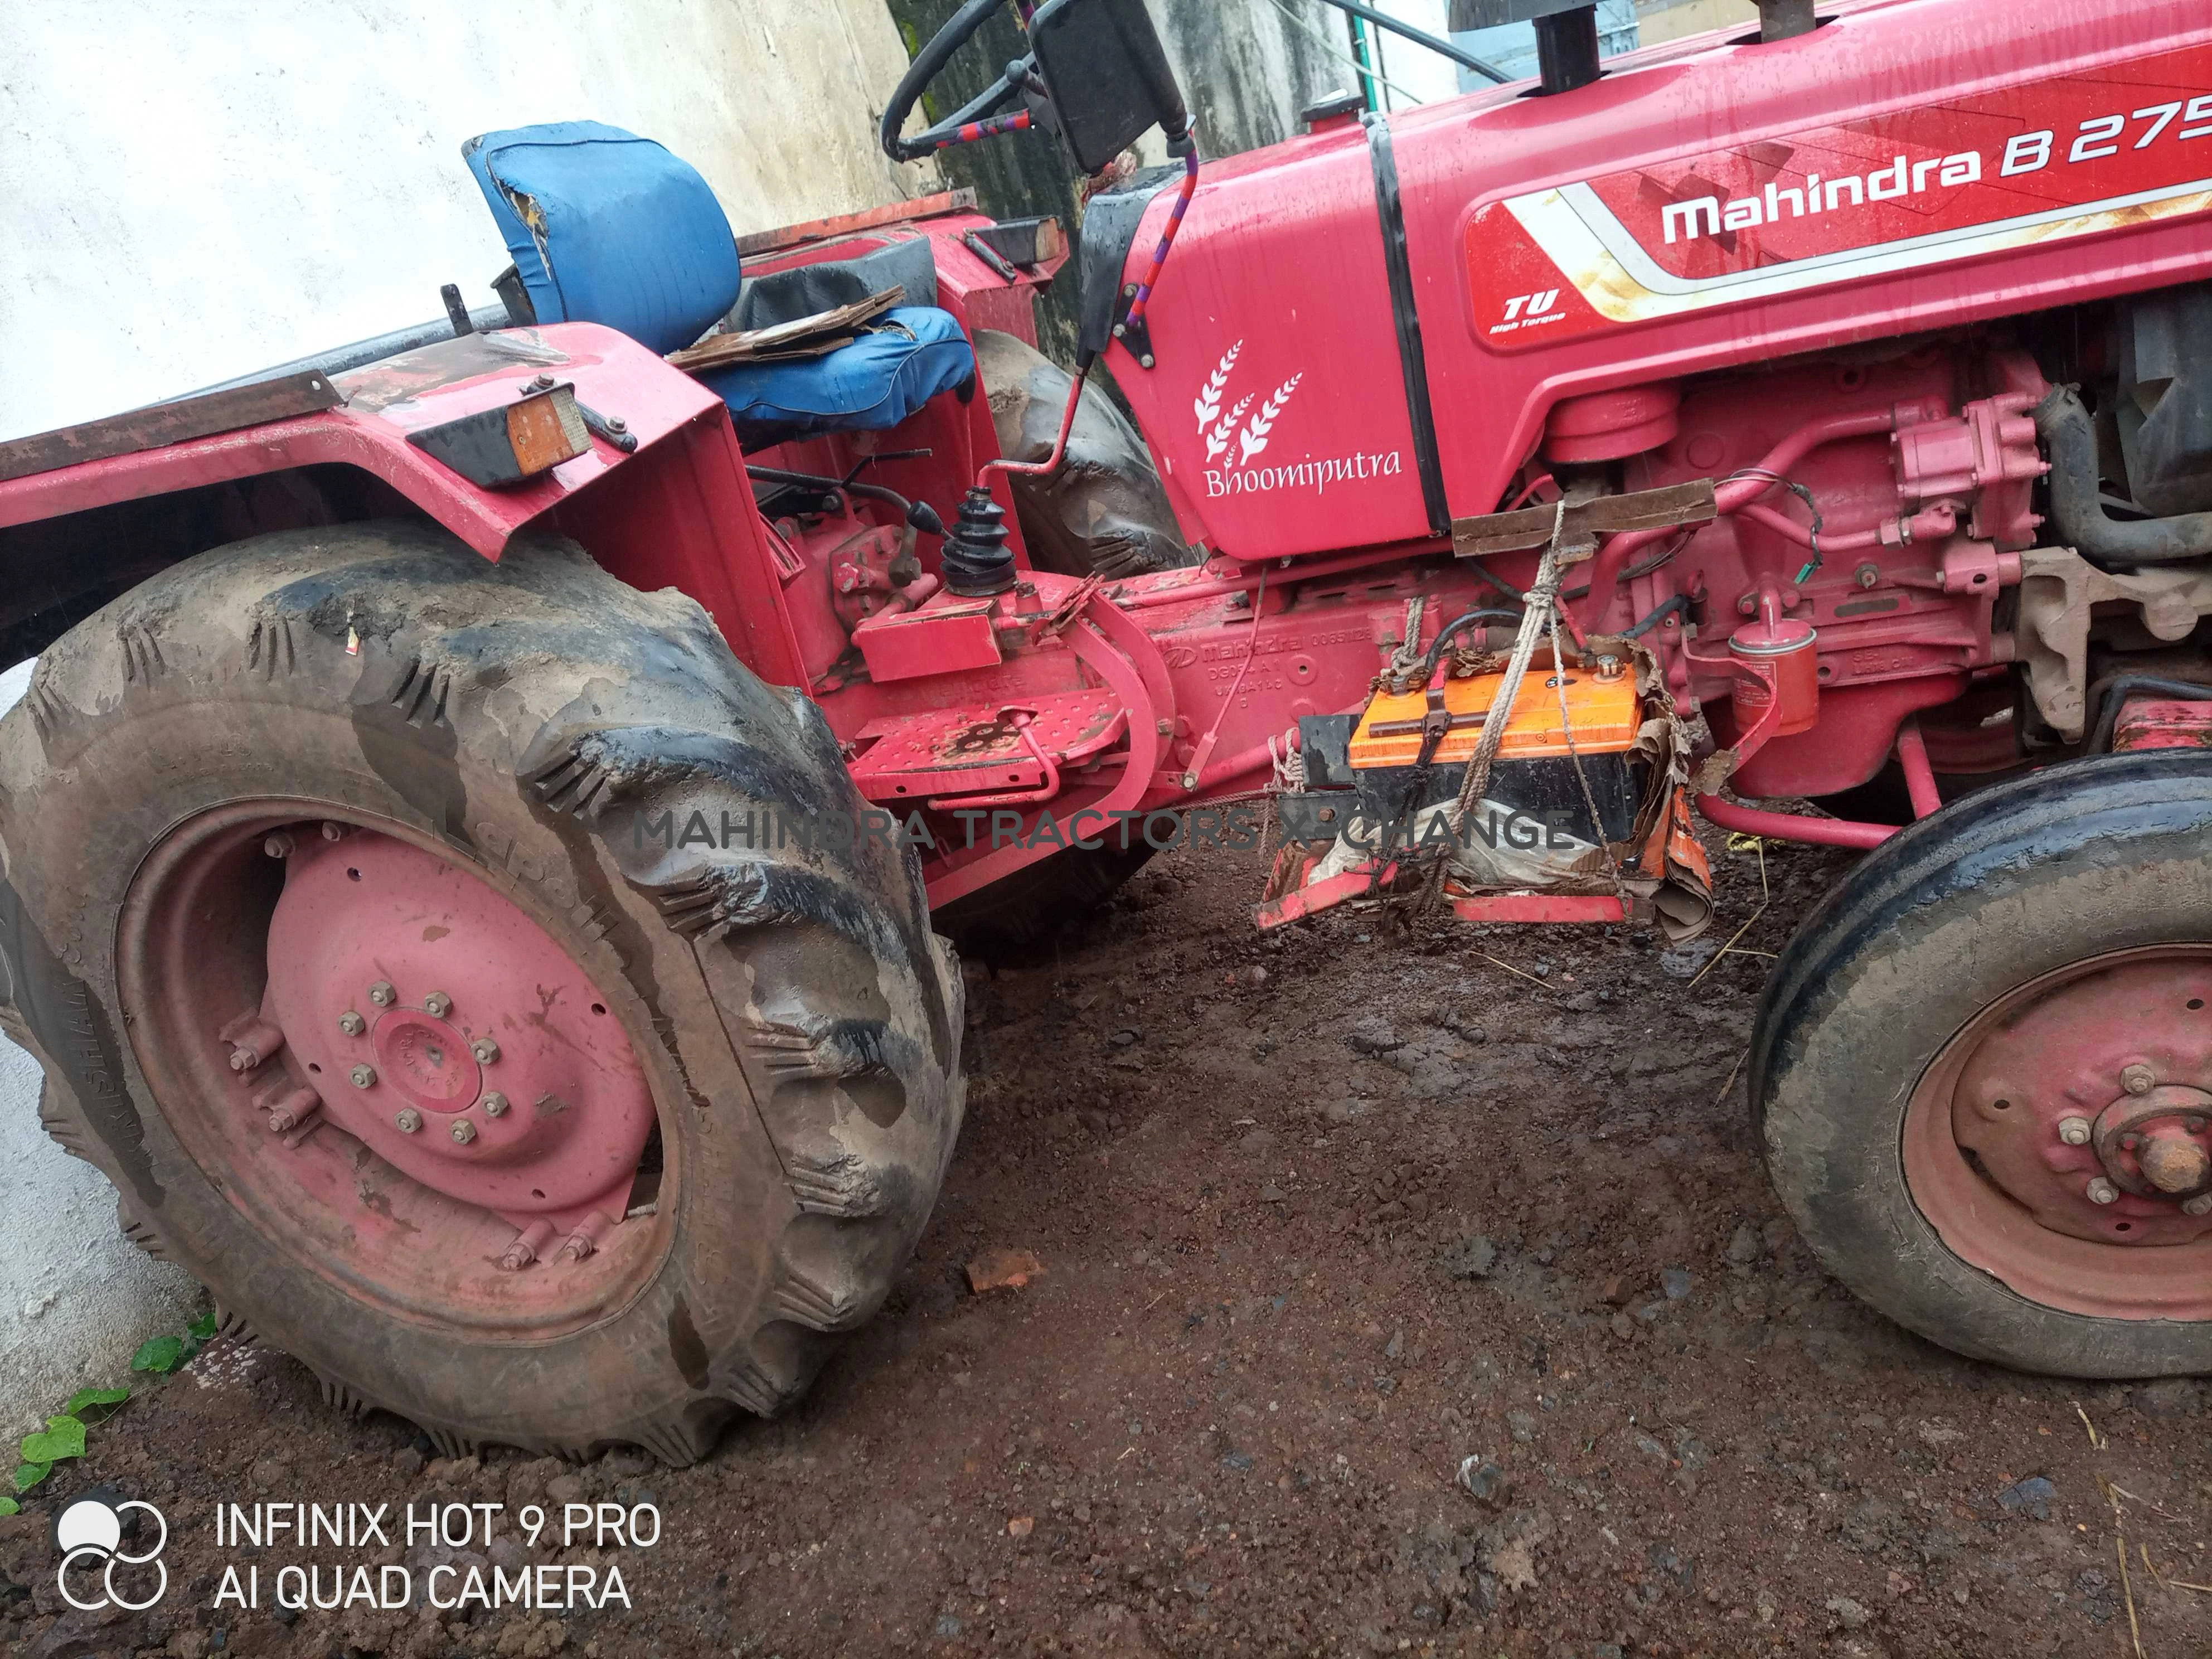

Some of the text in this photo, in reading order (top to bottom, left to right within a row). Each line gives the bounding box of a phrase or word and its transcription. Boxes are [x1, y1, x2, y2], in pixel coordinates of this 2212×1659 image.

[2000, 129, 2055, 177] B
[1502, 288, 1560, 321] TU
[1202, 450, 1403, 498] Bhoomiputra
